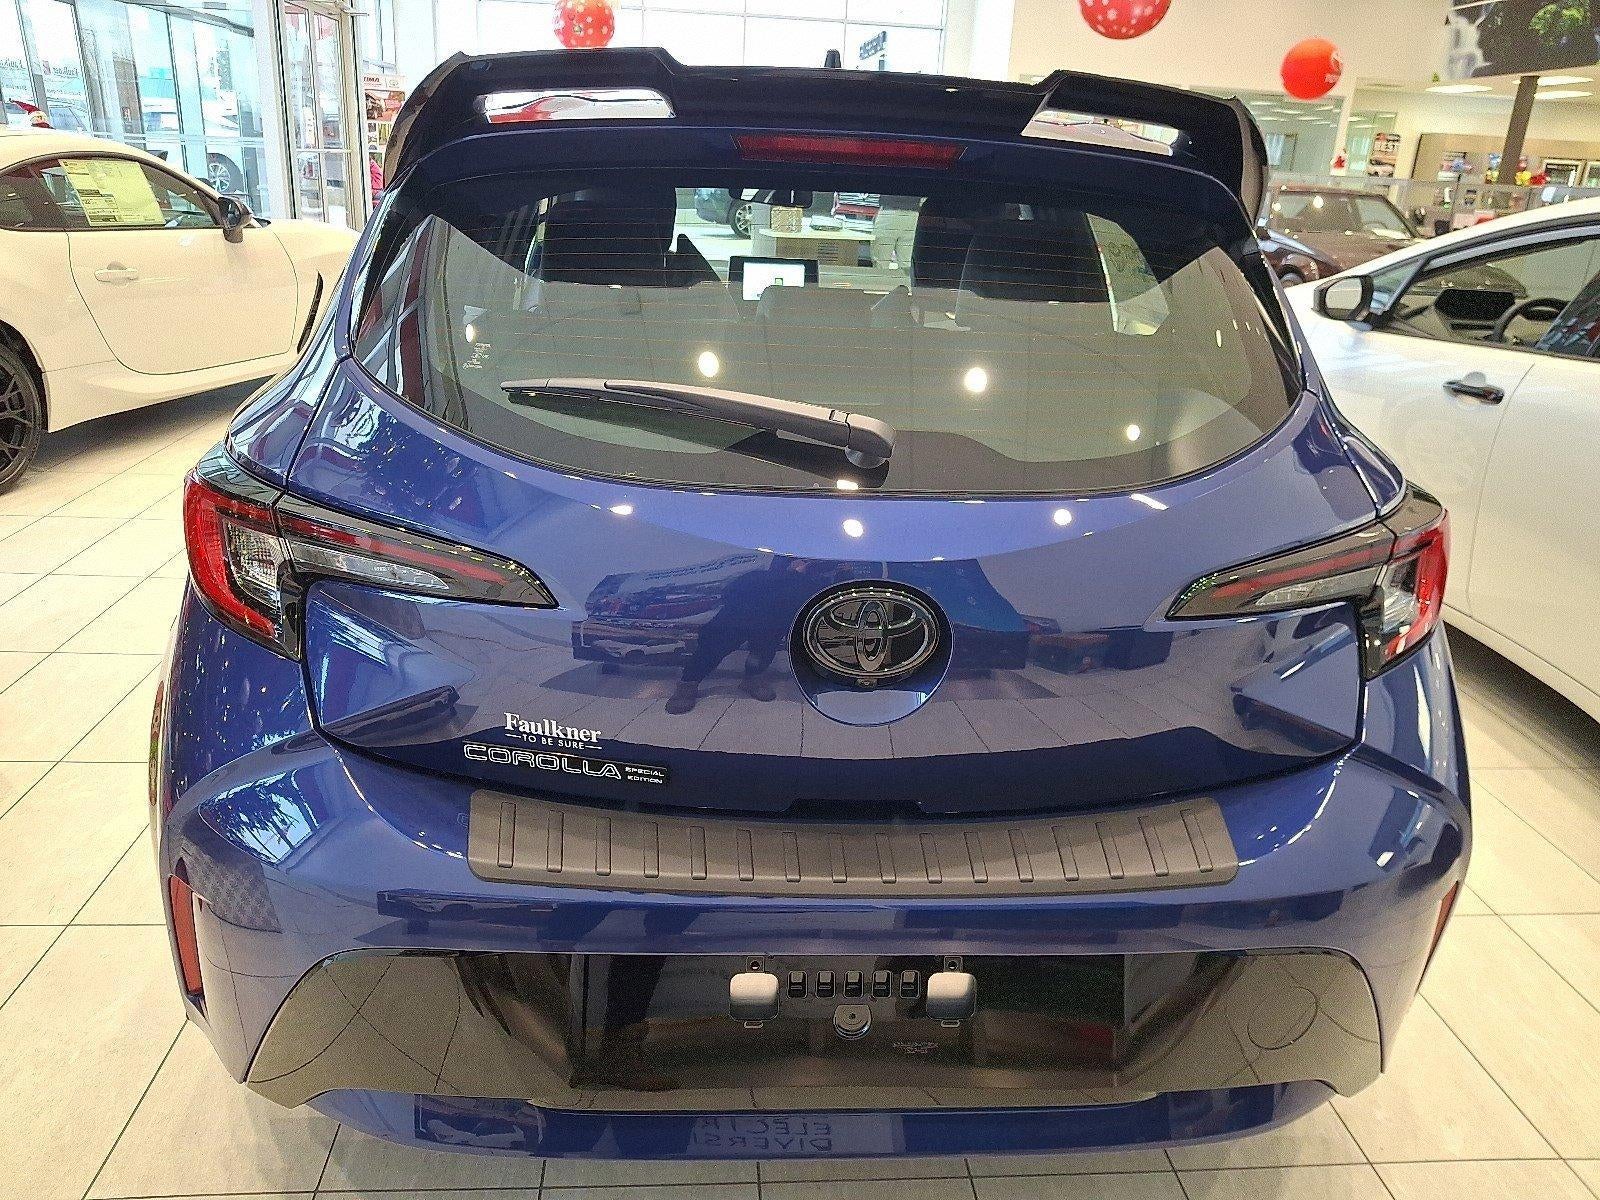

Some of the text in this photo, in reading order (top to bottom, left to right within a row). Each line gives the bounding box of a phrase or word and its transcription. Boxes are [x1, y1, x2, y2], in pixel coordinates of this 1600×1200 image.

[504, 712, 602, 743] Faulkner
[521, 734, 585, 750] TO BE SURE
[463, 744, 622, 780] COROLLA
[625, 766, 665, 777] SPECIAL
[627, 775, 664, 785] EDITION
